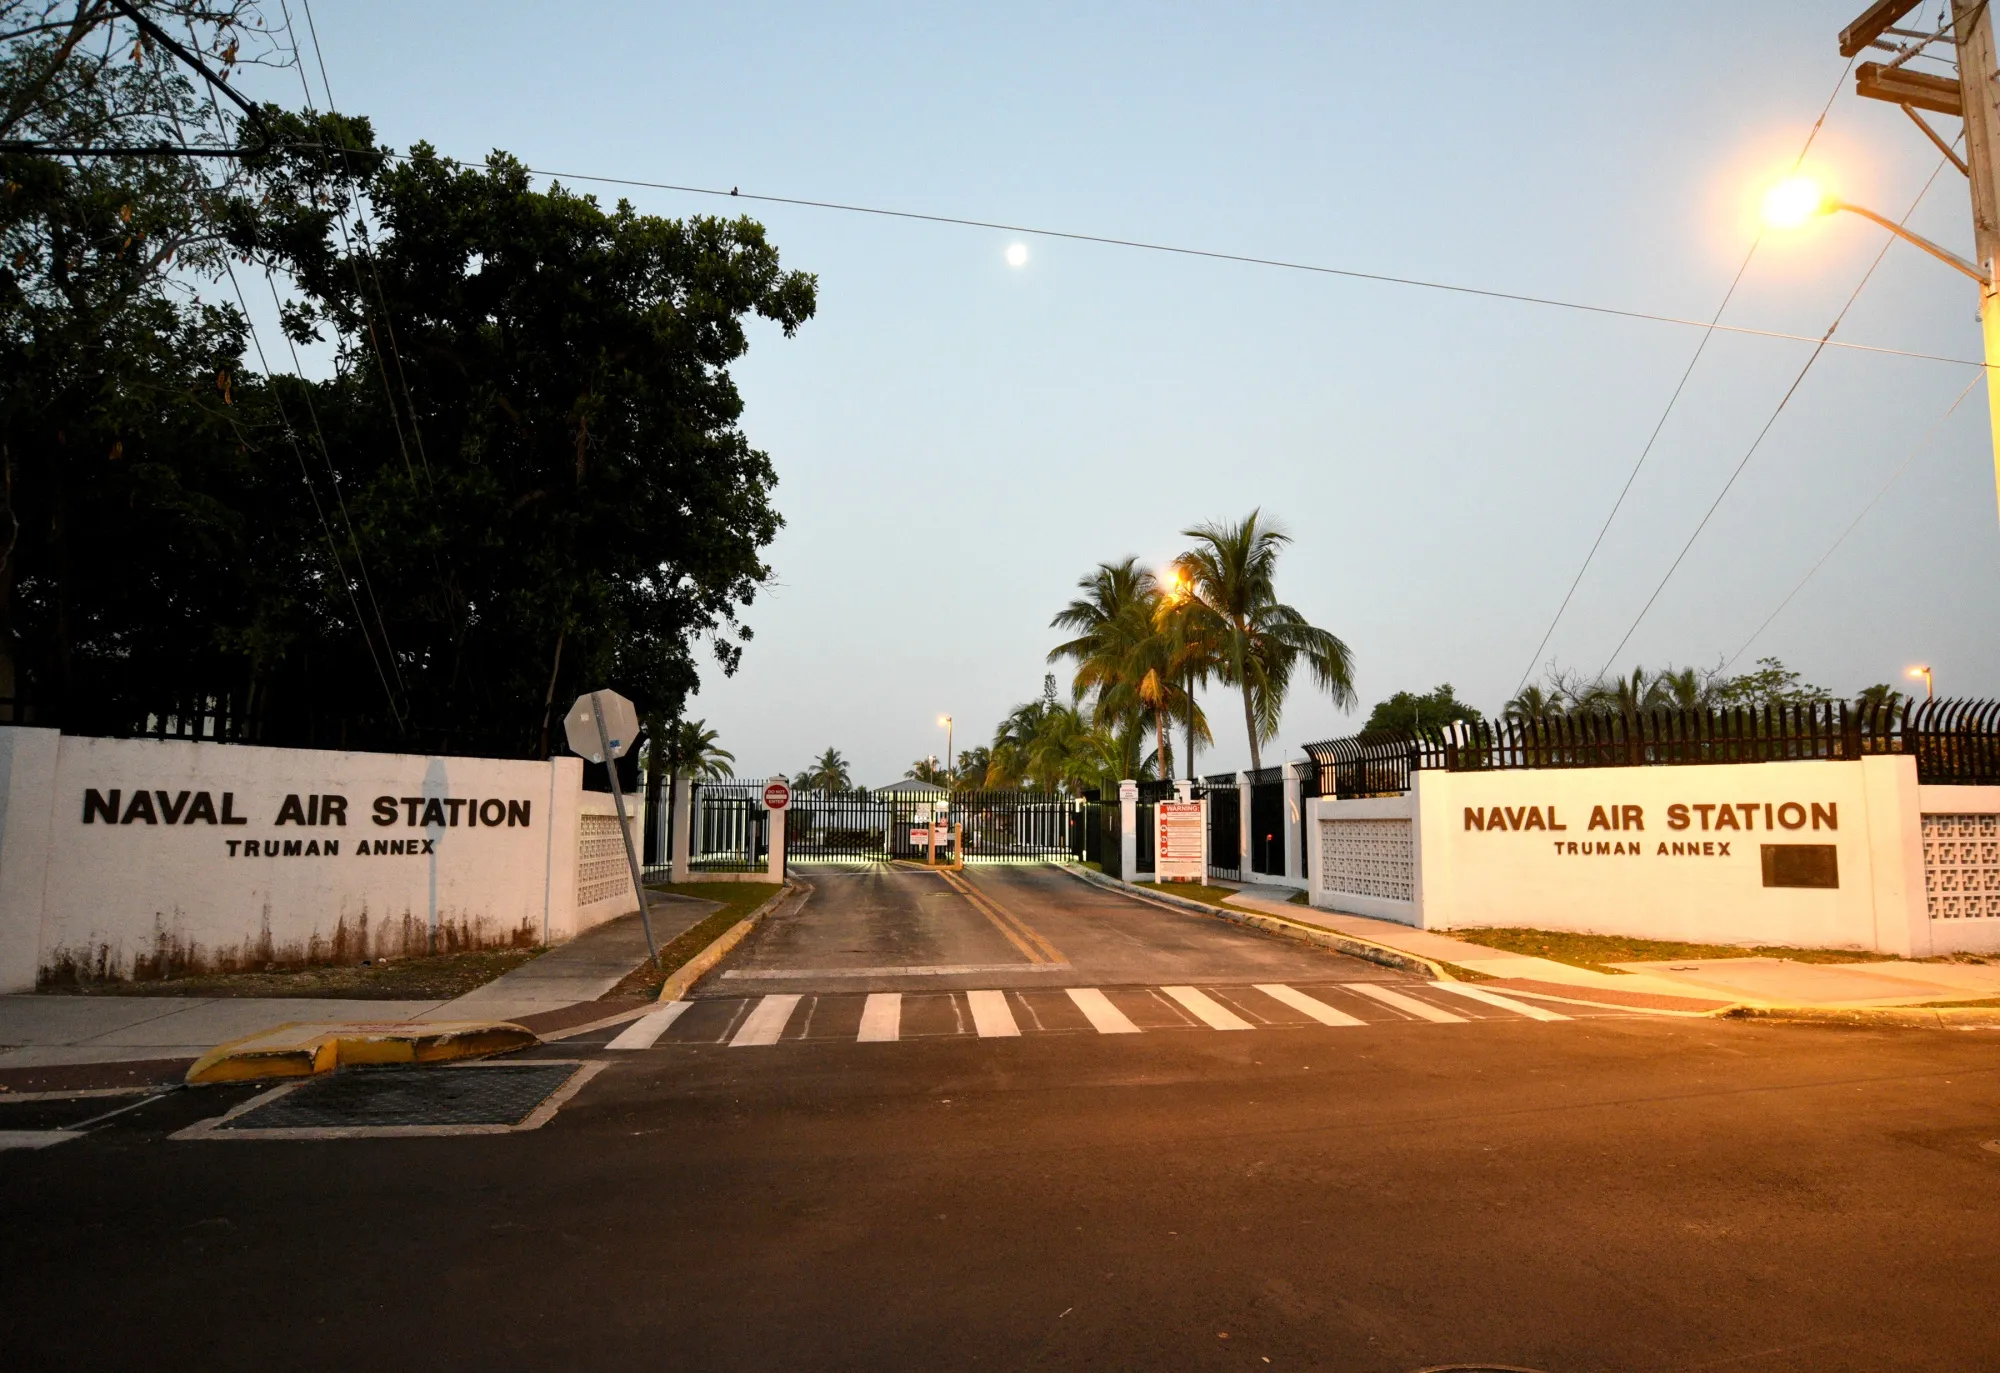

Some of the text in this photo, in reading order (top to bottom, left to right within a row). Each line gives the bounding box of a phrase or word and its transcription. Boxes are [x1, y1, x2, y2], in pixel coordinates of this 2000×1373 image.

[82, 788, 531, 827] NAVAL AIR STATION
[1464, 801, 1838, 832] NAVAL AIR STATION
[225, 839, 435, 857] TRUMAN ANNEX
[1553, 841, 1731, 857] TRUMAN ANNEX
